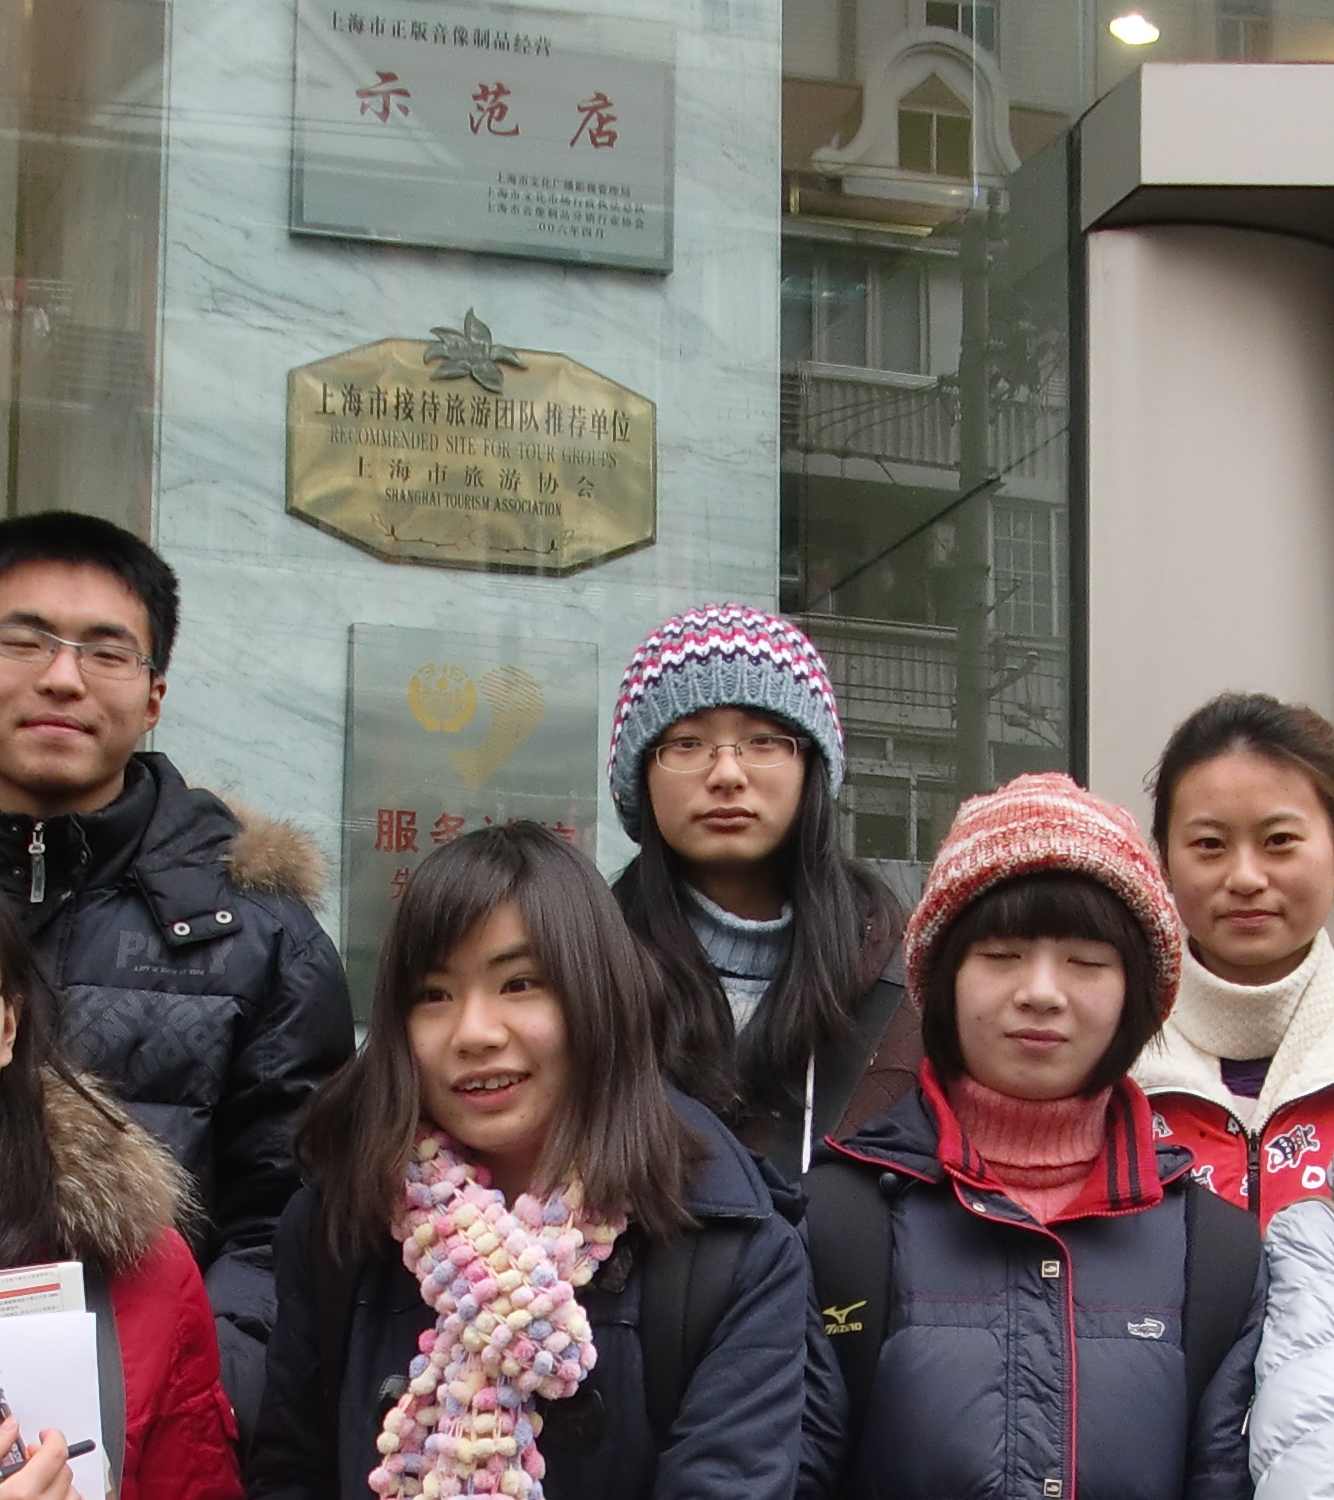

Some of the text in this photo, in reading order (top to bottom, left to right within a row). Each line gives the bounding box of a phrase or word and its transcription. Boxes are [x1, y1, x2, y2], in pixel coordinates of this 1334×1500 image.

[331, 10, 552, 57] 上海市正版音像制品经营
[355, 71, 620, 149] 示范店
[315, 382, 631, 443] 上海市接待旅游团队推荐单位
[329, 426, 618, 468] RECOMMENDED SITE FOR TOUR GROUPS
[354, 455, 595, 499] 上海市旅游协会
[385, 488, 562, 516] SHANGHAI TOURISM ASSOCIATION
[374, 808, 576, 853] 服务
